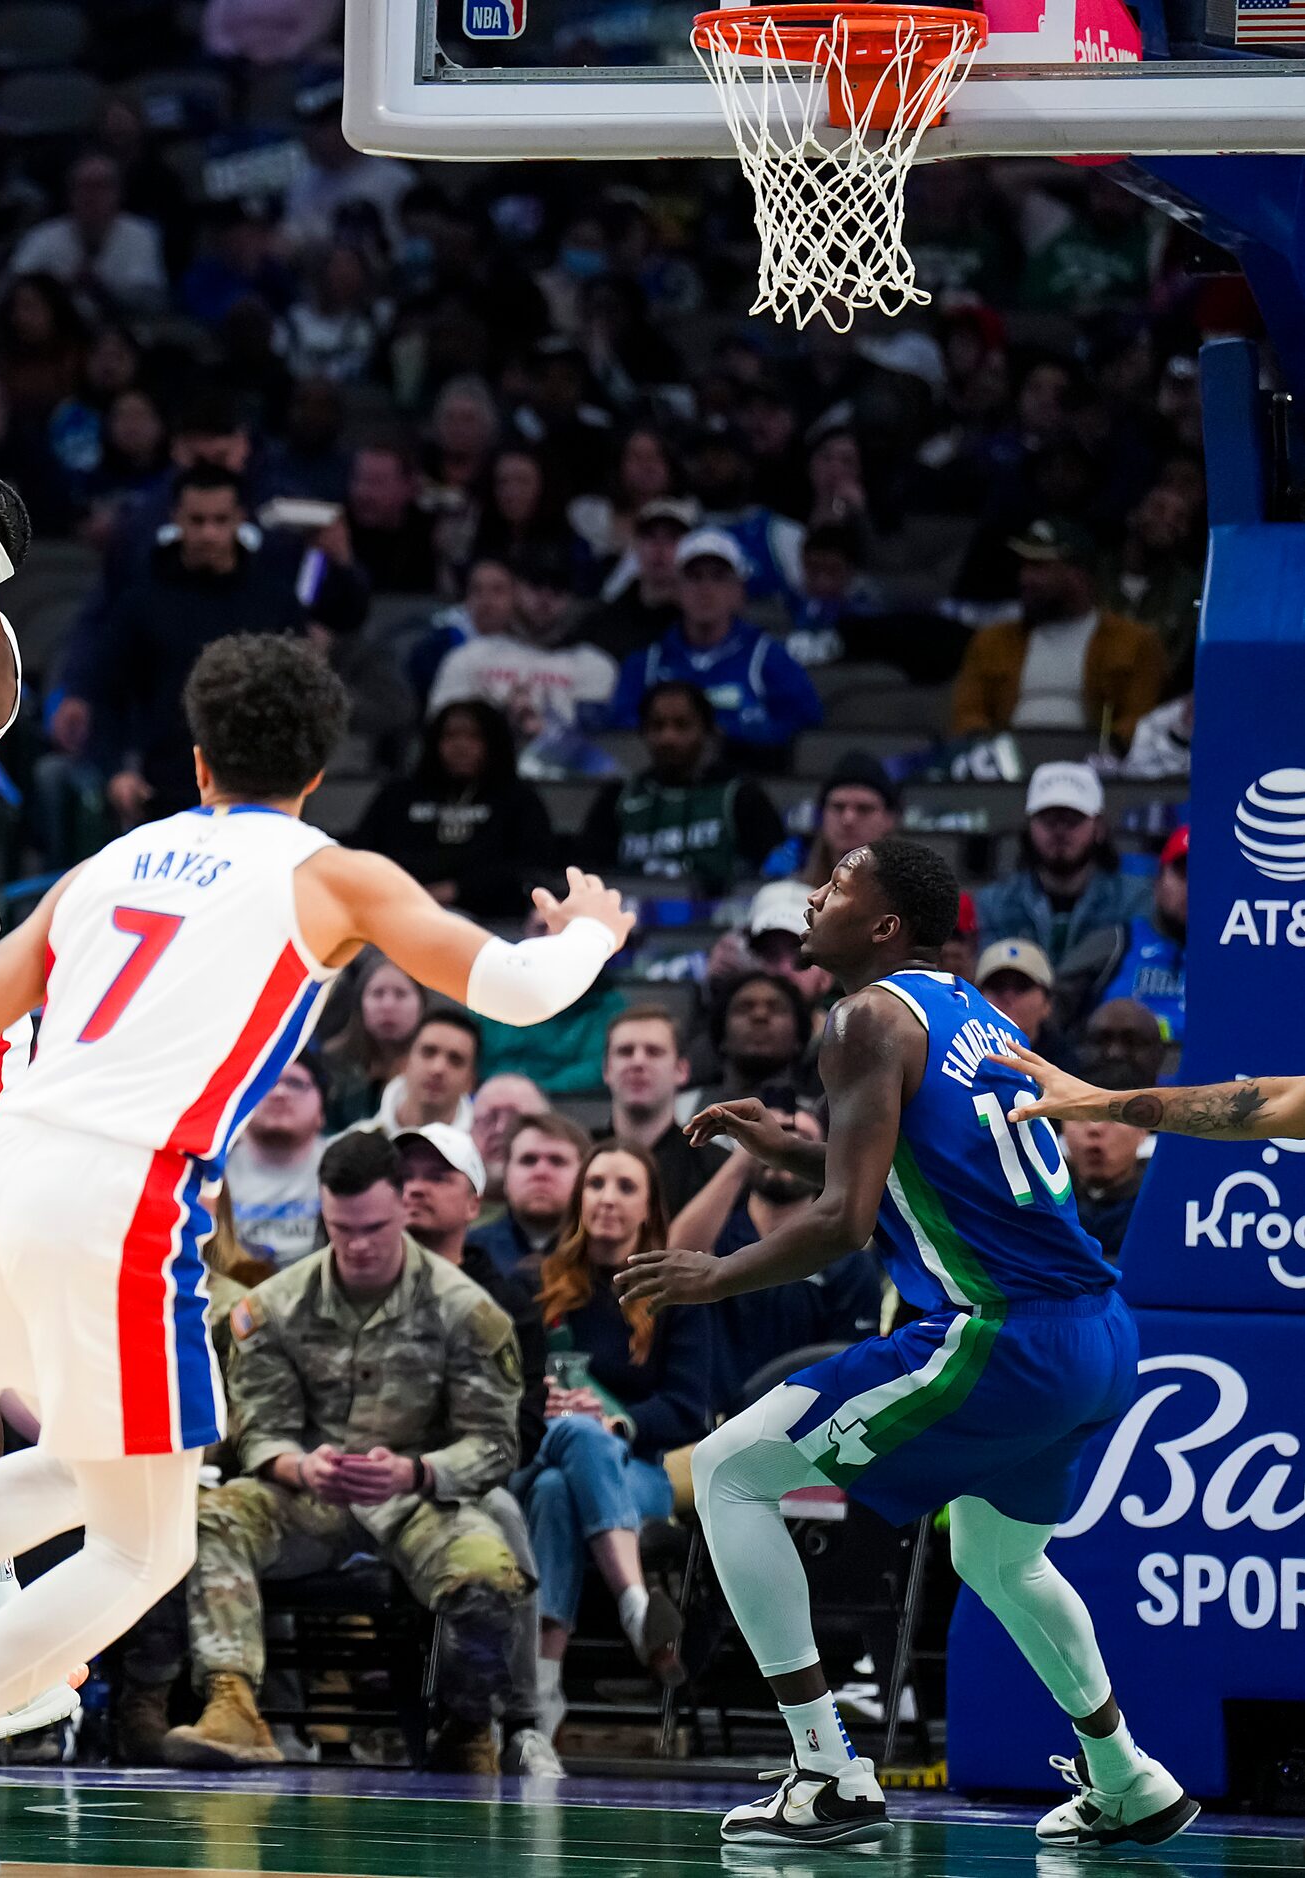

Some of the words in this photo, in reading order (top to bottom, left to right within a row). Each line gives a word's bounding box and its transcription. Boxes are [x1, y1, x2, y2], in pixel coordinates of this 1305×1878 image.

[472, 6, 502, 29] NBA
[132, 851, 232, 887] HAYES
[76, 904, 186, 1043] 7
[972, 1090, 1072, 1206] 10
